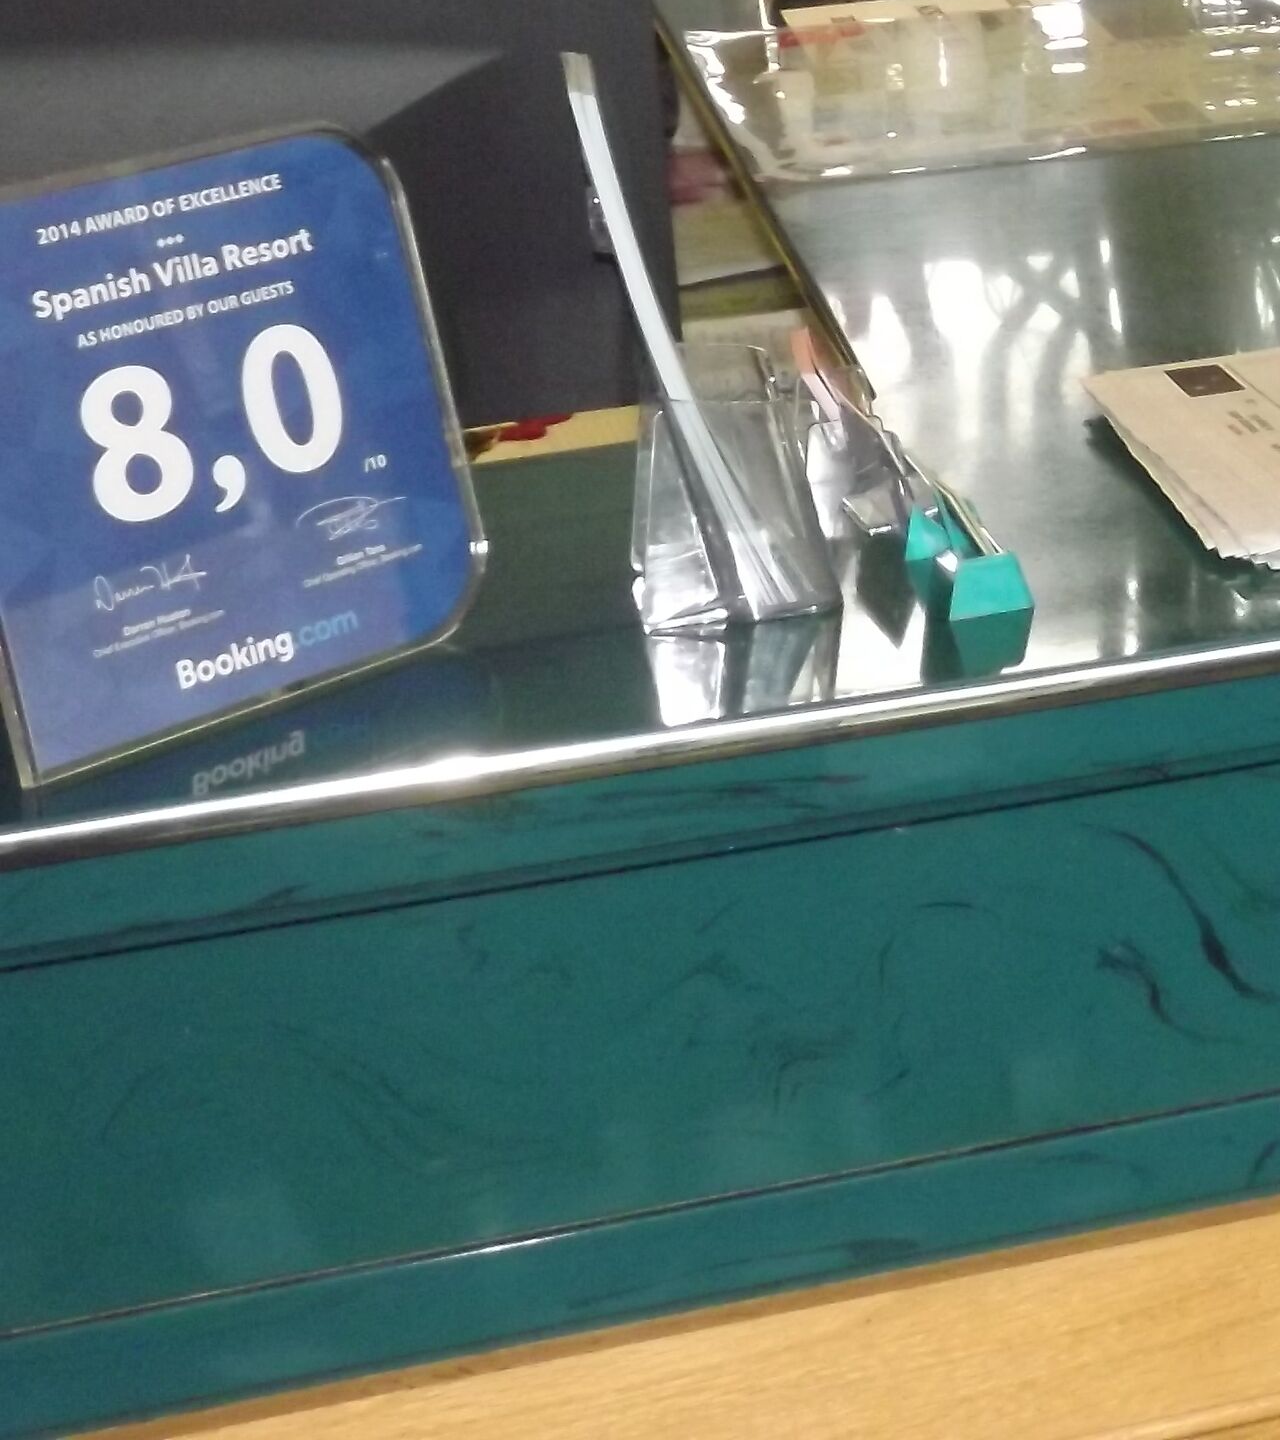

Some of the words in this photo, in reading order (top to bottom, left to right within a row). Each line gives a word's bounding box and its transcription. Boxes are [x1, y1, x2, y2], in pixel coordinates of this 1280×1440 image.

[36, 221, 82, 245] 2014
[85, 205, 149, 234] AWARD
[152, 198, 176, 217] OF
[179, 174, 282, 211] EXCELLENCE
[32, 268, 151, 320] Spanish
[152, 252, 220, 288] Villa
[221, 229, 314, 271] Resort
[77, 333, 98, 348] AS
[99, 309, 184, 343] HONOURED
[186, 302, 205, 320] BY
[207, 294, 240, 314] OUR
[239, 281, 296, 306] GUESTS
[79, 324, 343, 522] 8,0
[364, 454, 388, 473] /10
